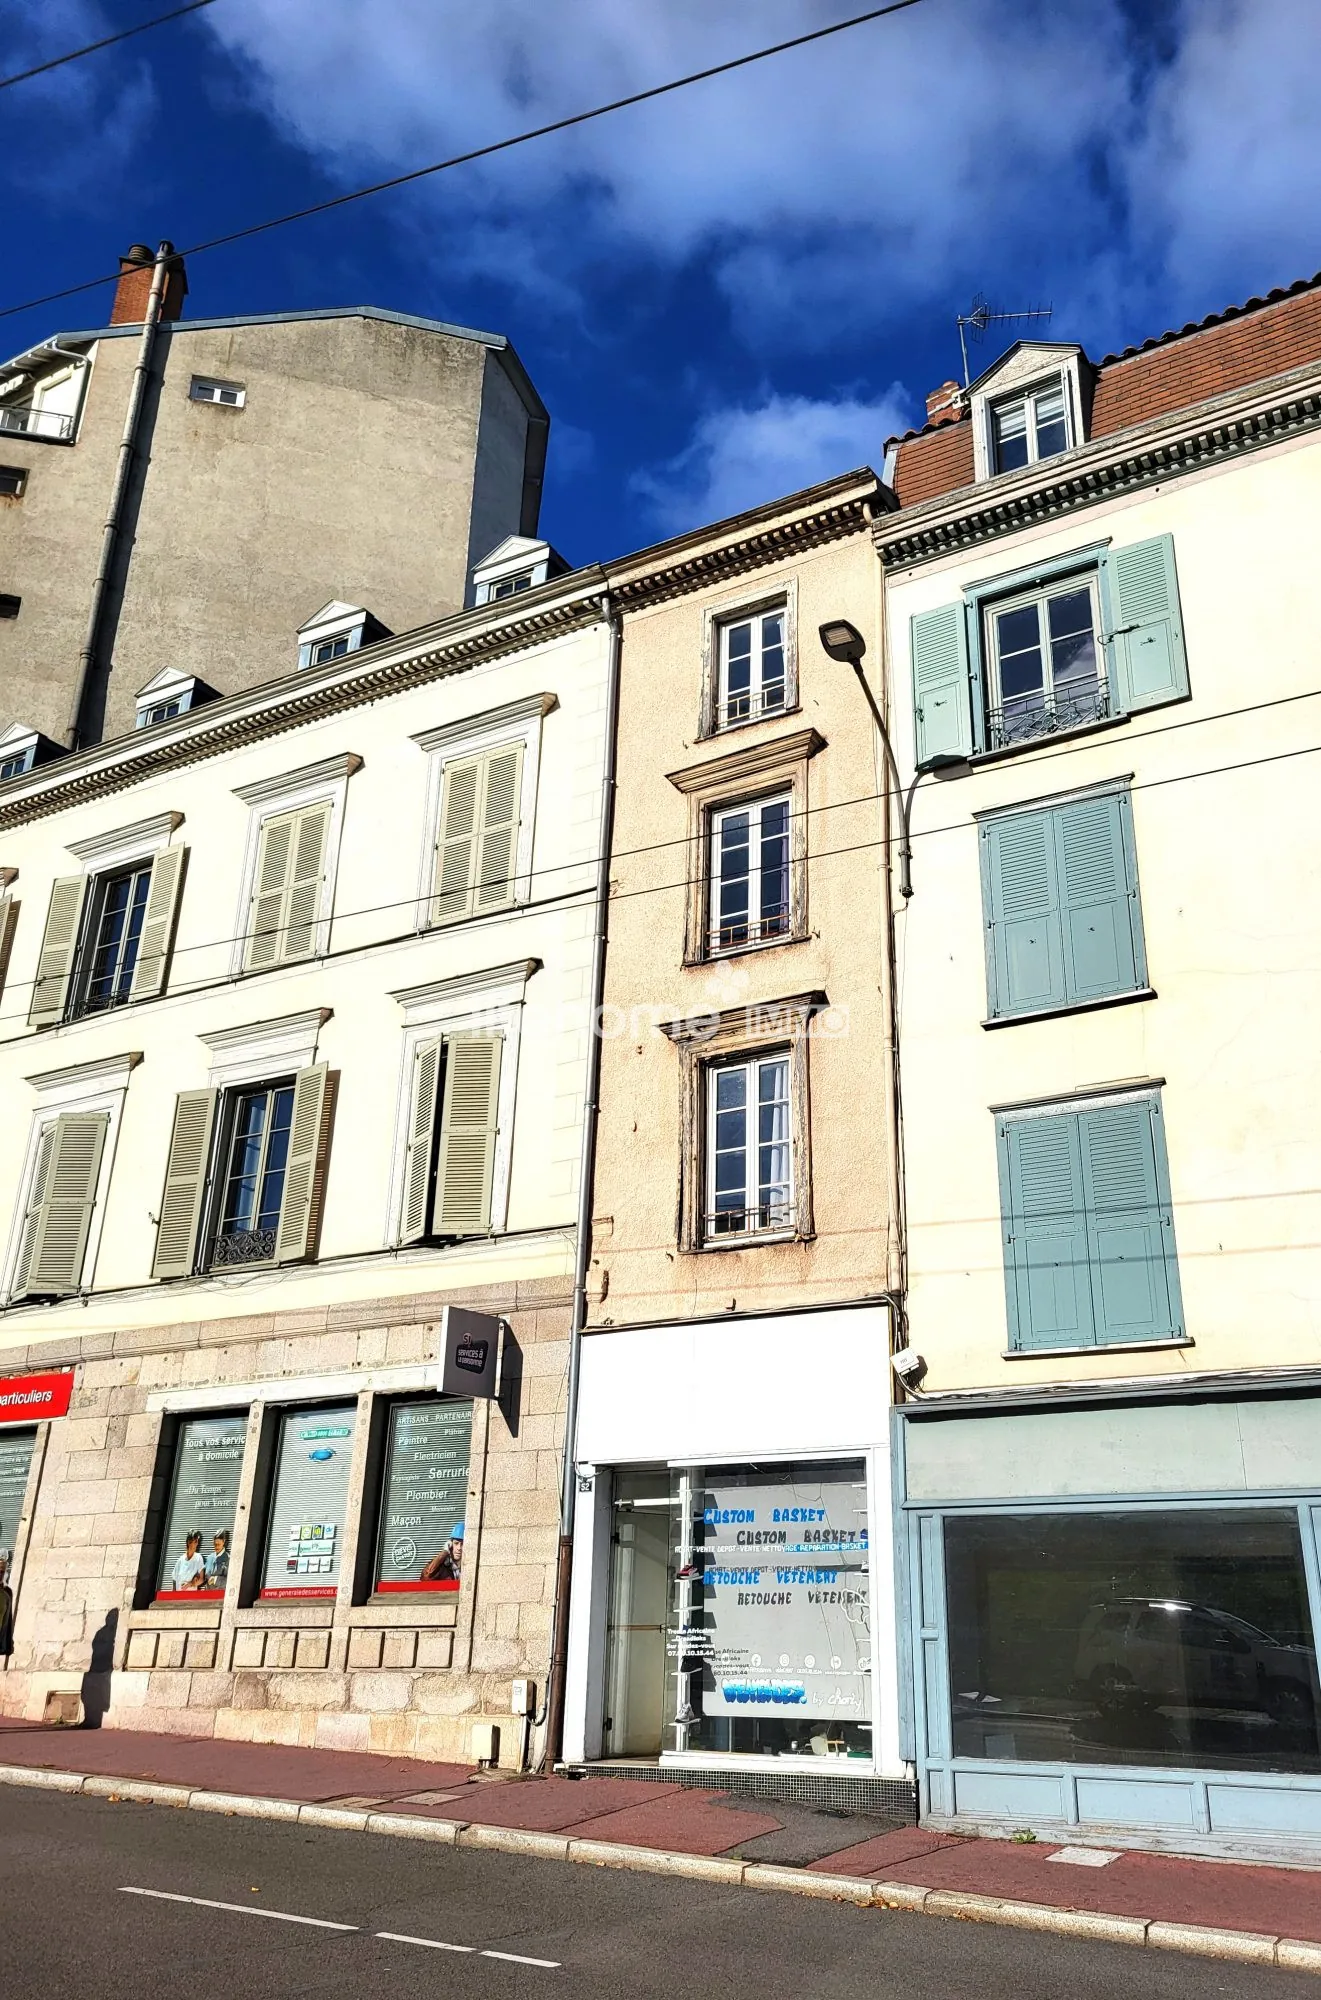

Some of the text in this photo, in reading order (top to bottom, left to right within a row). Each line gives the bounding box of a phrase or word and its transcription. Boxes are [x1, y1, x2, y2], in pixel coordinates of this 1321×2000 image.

[398, 1415, 429, 1425] ARTISANS
[186, 1438, 204, 1448] Tous
[206, 1437, 220, 1446] vos
[398, 1436, 428, 1446] Peintre
[206, 1449, 239, 1461] domicile
[414, 1450, 456, 1461] Electricien
[581, 1482, 590, 1492] 52
[406, 1489, 448, 1501] Plombier
[392, 1515, 422, 1528] Maçon
[704, 1508, 825, 1525] CUSTOM BASKET
[776, 1571, 838, 1584] VETEMENT
